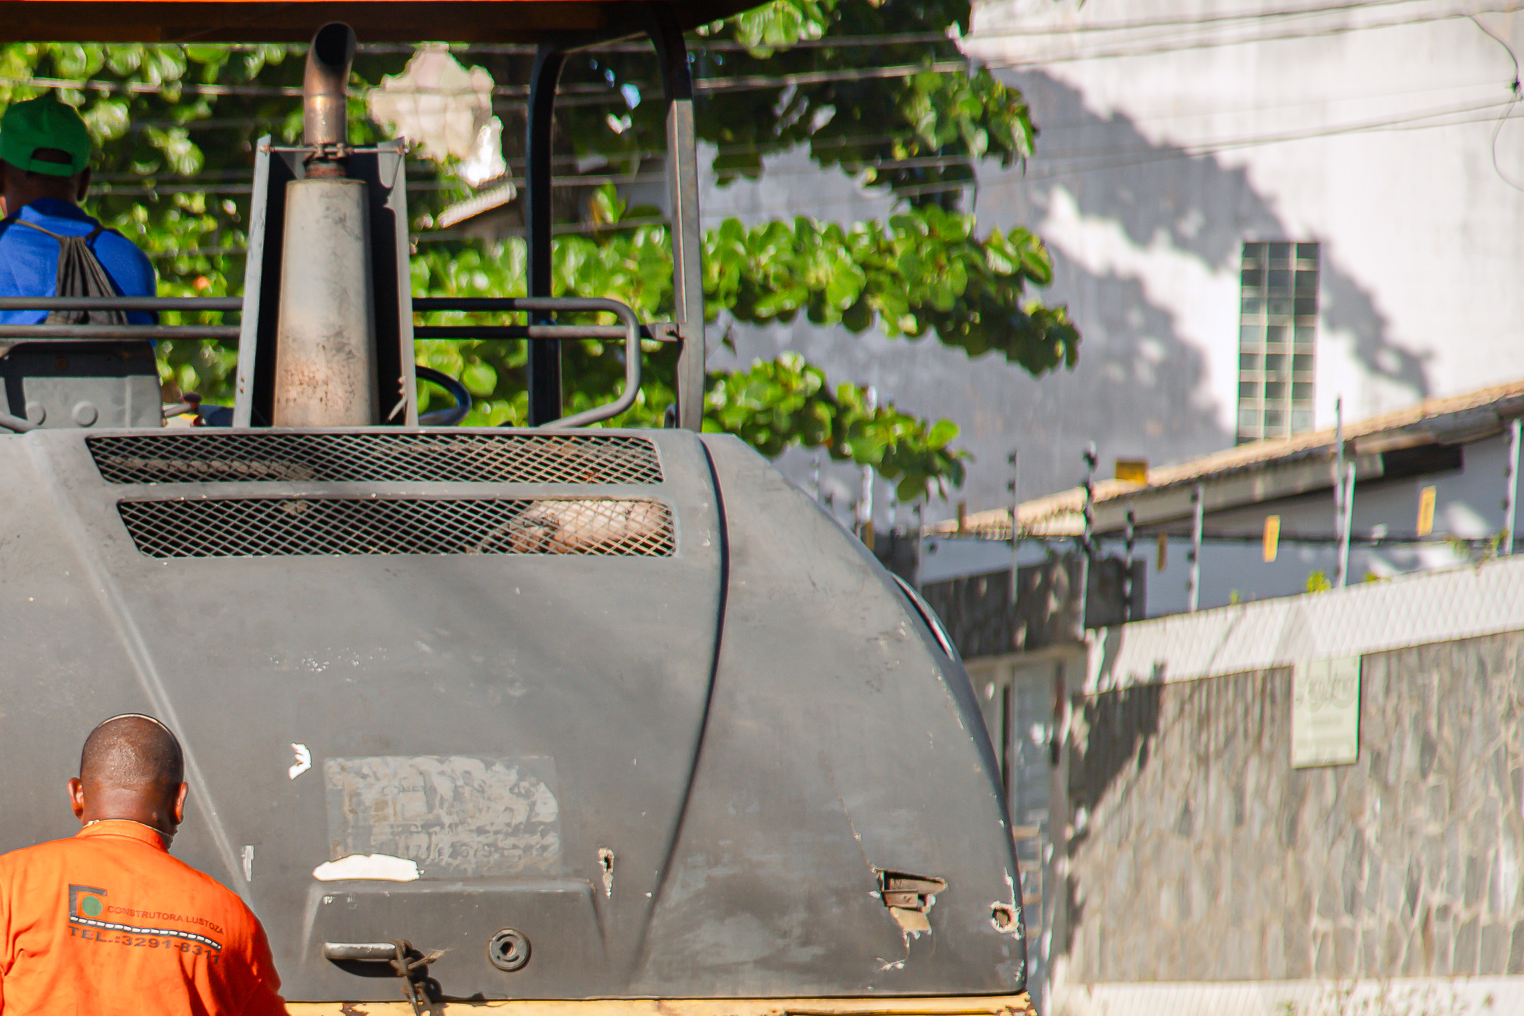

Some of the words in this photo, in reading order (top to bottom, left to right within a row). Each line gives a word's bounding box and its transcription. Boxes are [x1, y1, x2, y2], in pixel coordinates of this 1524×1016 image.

[107, 905, 184, 922] CONSTRUTORA
[186, 915, 225, 936] LUSTOZA
[68, 925, 220, 965] TEL.:3291-8311
